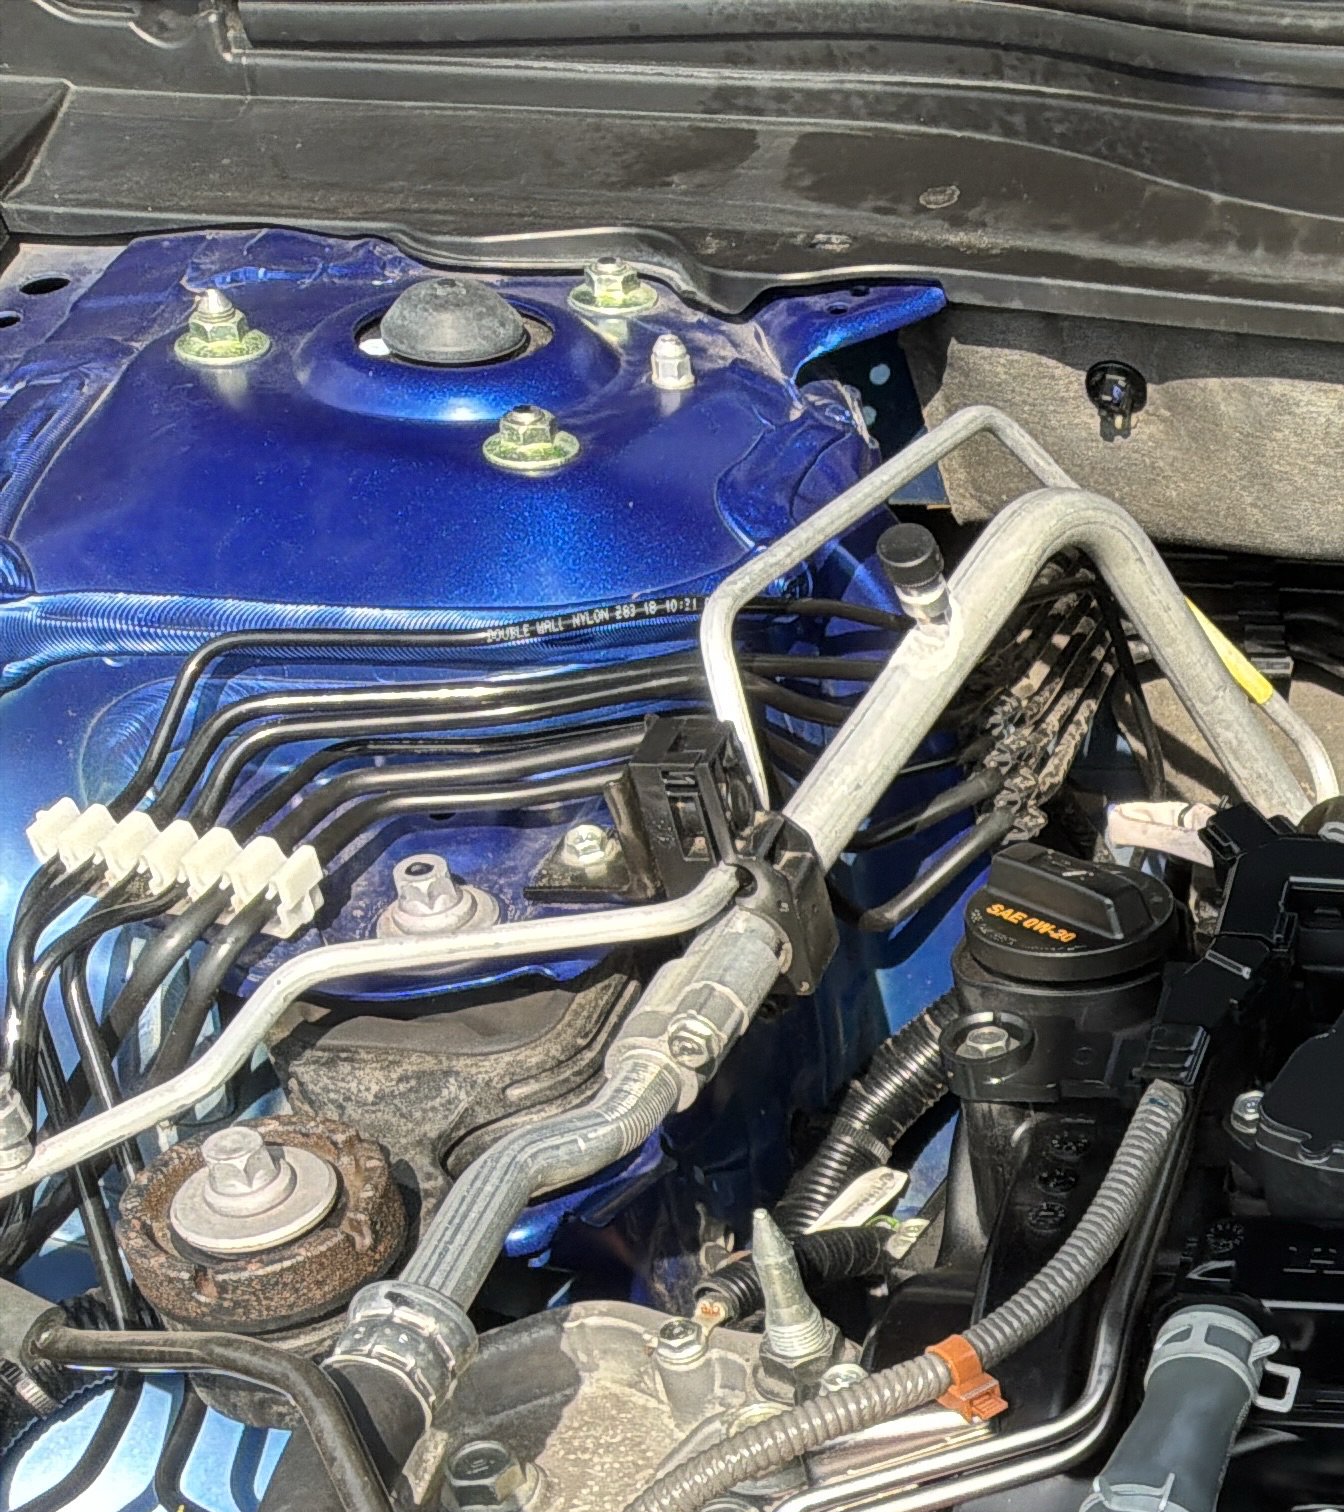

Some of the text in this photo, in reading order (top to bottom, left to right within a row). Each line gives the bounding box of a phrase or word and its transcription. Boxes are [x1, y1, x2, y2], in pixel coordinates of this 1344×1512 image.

[572, 608, 610, 628] NYLON
[986, 903, 1028, 925] SAE
[1022, 916, 1077, 943] 0W-20
